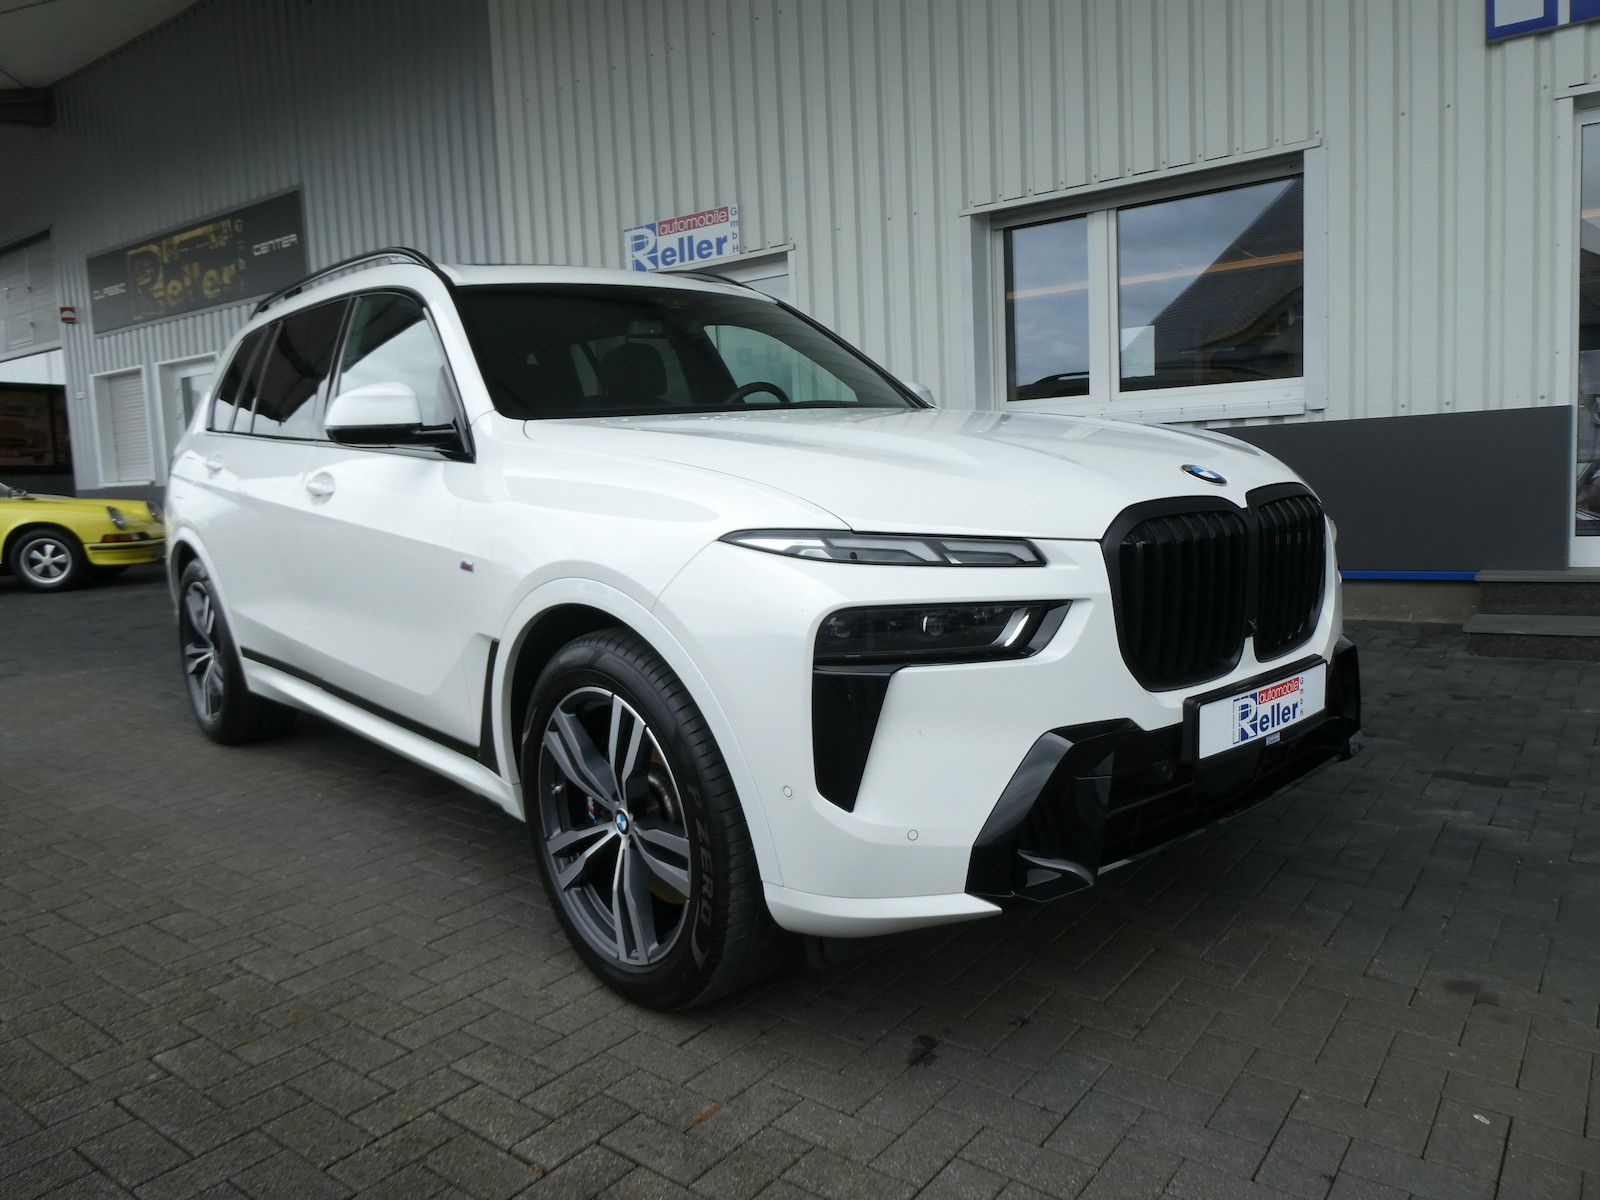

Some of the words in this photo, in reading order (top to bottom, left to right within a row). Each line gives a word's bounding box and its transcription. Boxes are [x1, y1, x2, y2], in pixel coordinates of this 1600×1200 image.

[660, 210, 727, 235] automobile
[730, 207, 738, 253] GmbH
[624, 226, 727, 271] Reller
[1259, 679, 1299, 704] automobile
[1233, 693, 1298, 744] Reller
